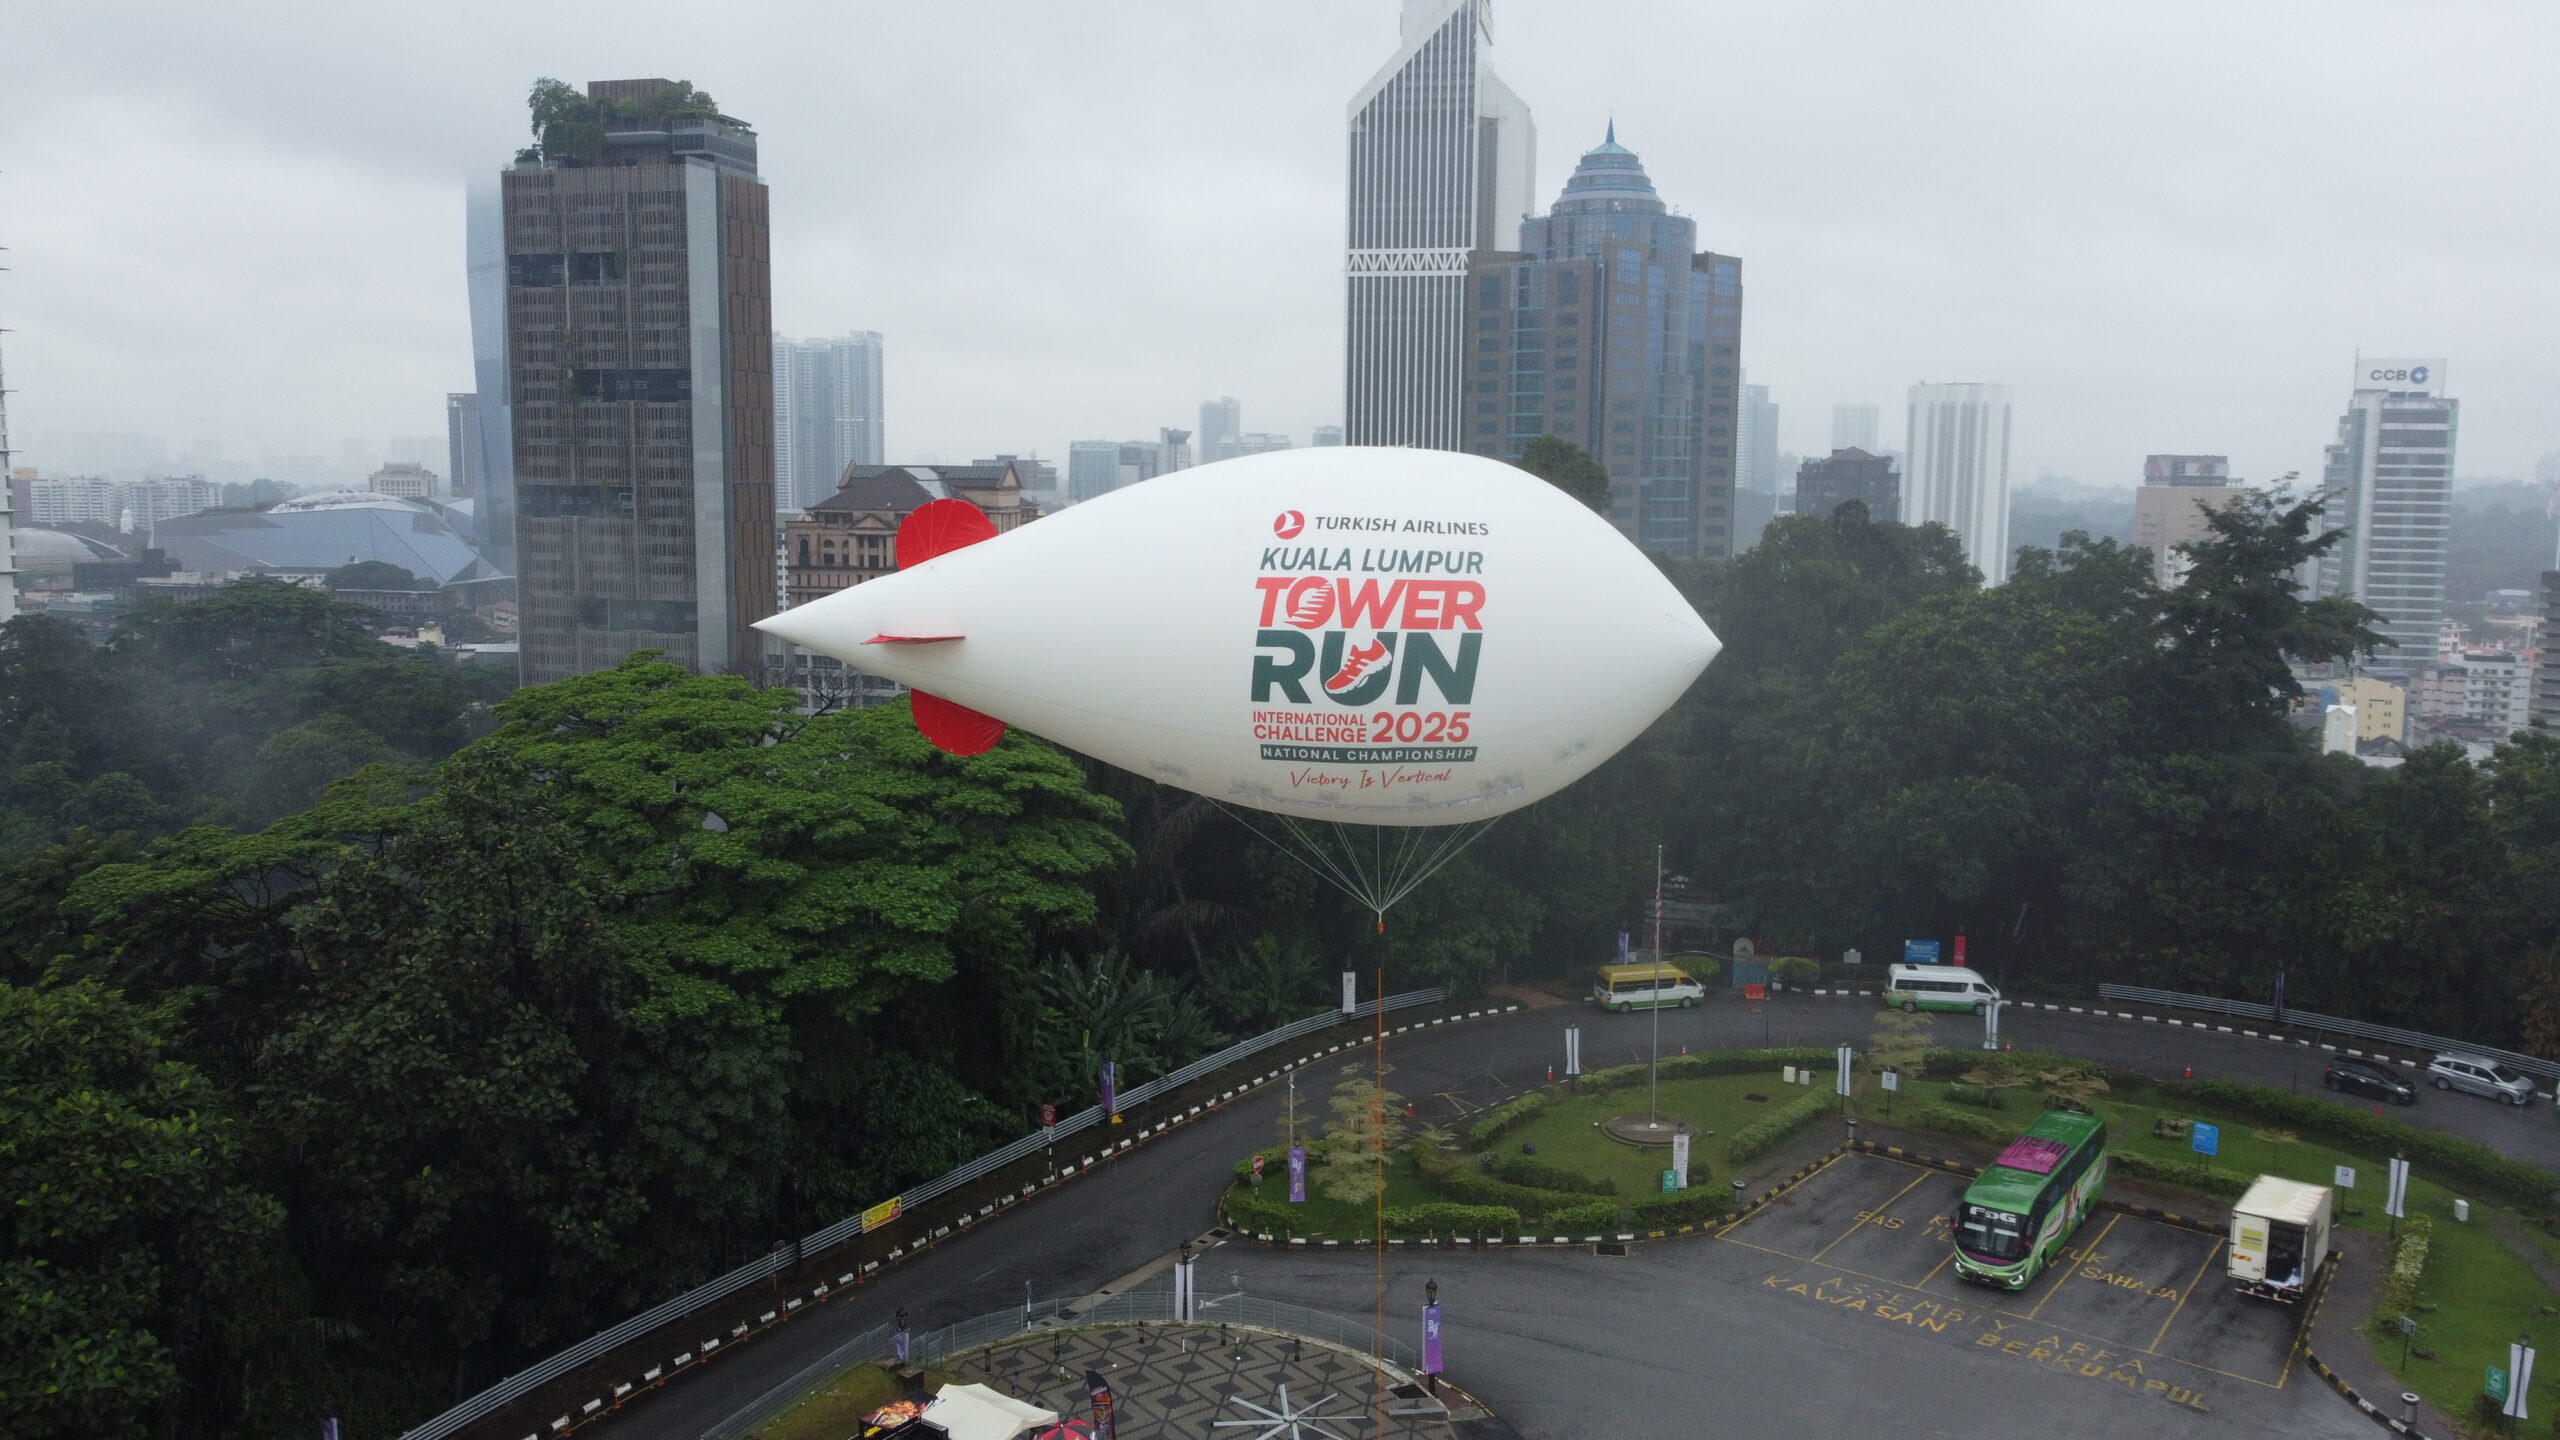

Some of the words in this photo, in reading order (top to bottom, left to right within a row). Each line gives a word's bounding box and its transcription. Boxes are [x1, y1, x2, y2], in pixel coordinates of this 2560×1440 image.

[2370, 369, 2407, 381] CCB
[1315, 516, 1396, 532] TURKISH
[1402, 519, 1489, 536] AIRLINES
[1259, 547, 1352, 571] KUALA
[1361, 548, 1484, 574] LUMPUR
[1255, 575, 1486, 630] TOWER
[1250, 629, 1484, 706] RUN
[1252, 711, 1367, 727] INTERNATIONAL
[1371, 711, 1471, 743] 2025
[1253, 725, 1367, 743] CHALLENGE
[1262, 747, 1340, 761] NATIONAL
[1347, 748, 1473, 761] CHAMPIONSHIP
[1290, 767, 1351, 789] Victory
[1359, 769, 1376, 789] Is
[1381, 765, 1452, 789] Vertical
[1853, 1210, 1904, 1229] BAS
[1969, 1206, 2017, 1223] FDG
[1762, 1275, 1948, 1332] KAWASAN
[1975, 1333, 2212, 1412] BERKUMPUL
